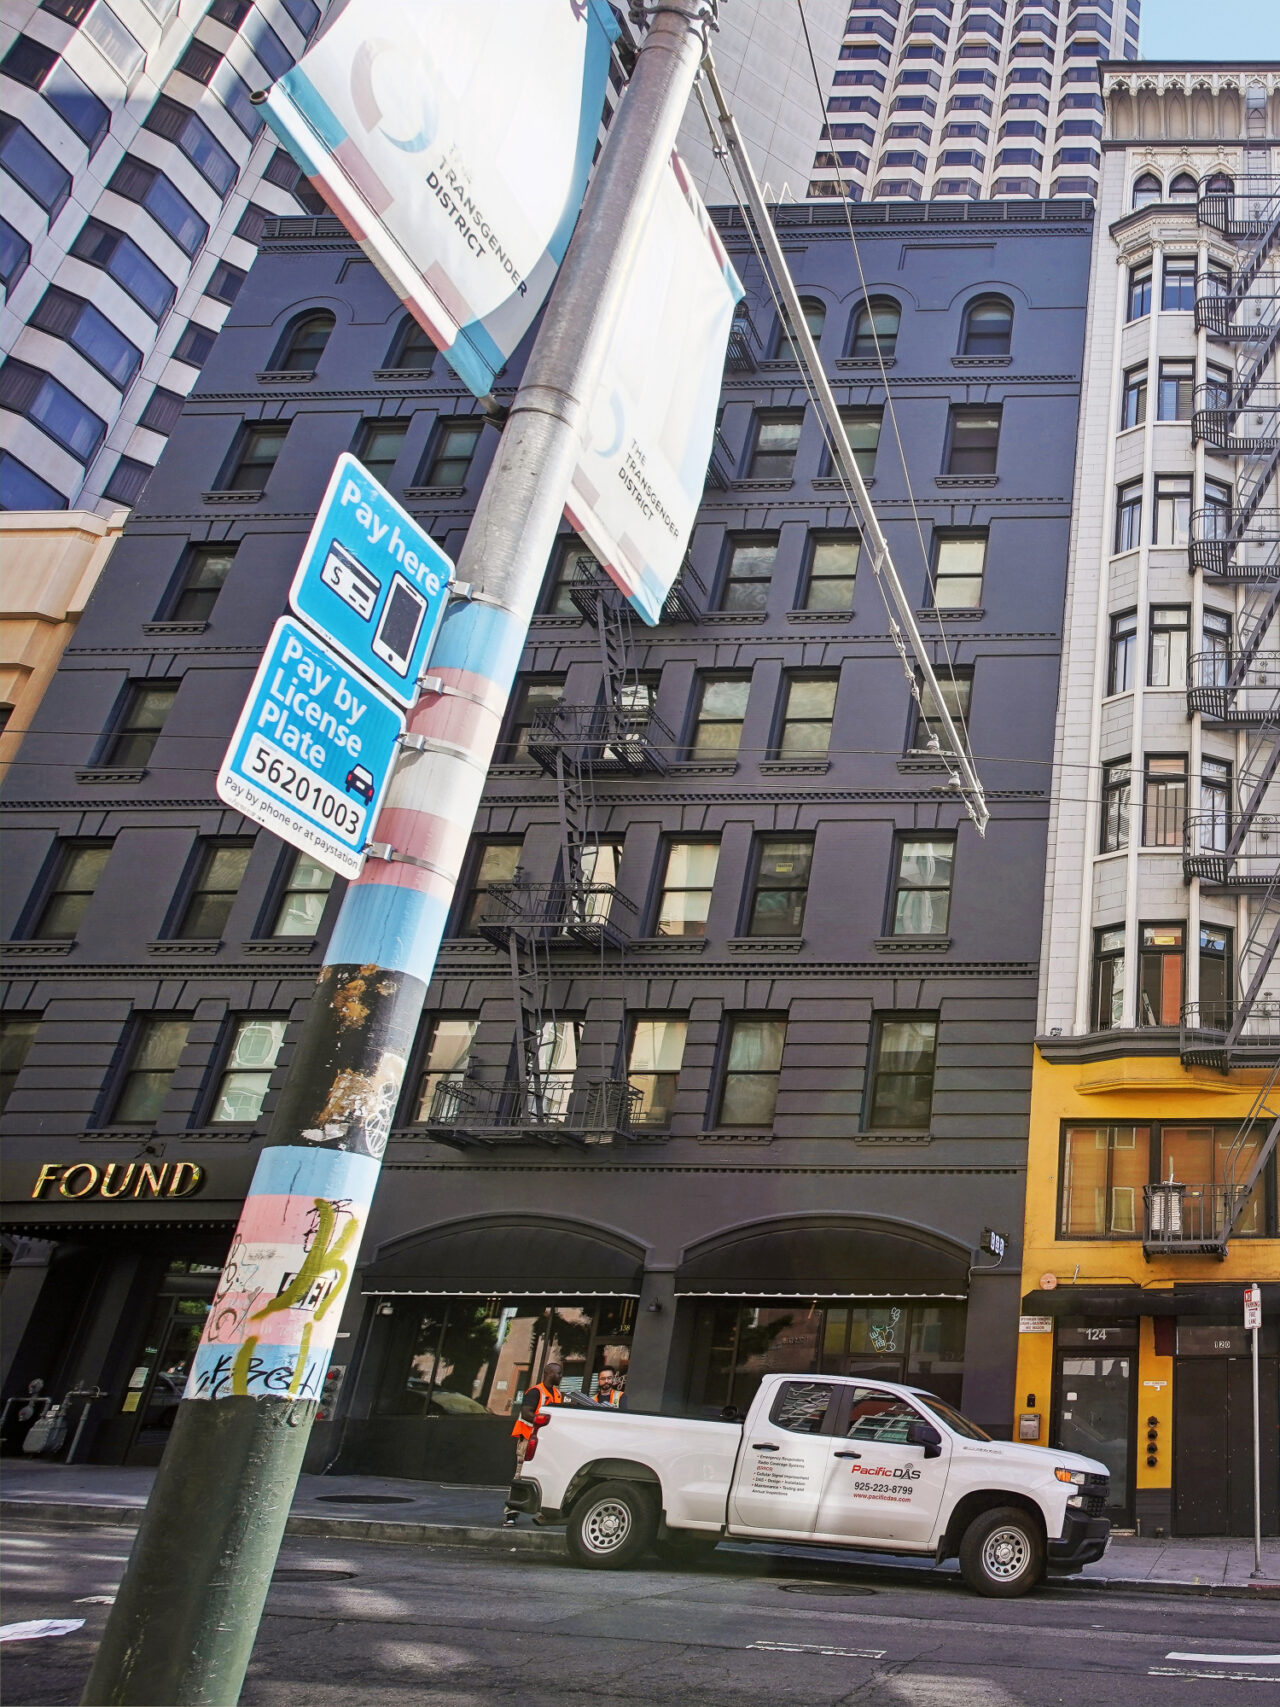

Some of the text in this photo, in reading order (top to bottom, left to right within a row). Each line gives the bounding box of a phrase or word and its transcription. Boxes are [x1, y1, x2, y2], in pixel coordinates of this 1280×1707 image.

[425, 171, 486, 258] DISTRICT
[438, 155, 528, 298] TRANSGENDER
[631, 437, 647, 467] THE
[618, 467, 654, 521] DISTRICT
[626, 452, 680, 540] TRANSGENDER
[340, 479, 441, 597] Pay here
[270, 667, 363, 758] License
[280, 635, 368, 725] Pay by
[257, 699, 327, 769] Plate
[225, 776, 245, 797] Pay
[245, 789, 260, 806] by
[260, 801, 291, 826] phone
[292, 822, 303, 834] or
[303, 828, 315, 842] at
[314, 836, 359, 870] paystation
[252, 747, 361, 836] 56201003
[31, 1162, 202, 1199] FOUND
[1085, 1328, 1107, 1340] 124
[1214, 1341, 1230, 1349] 120
[853, 1493, 911, 1502] www.pacificdas.com
[854, 1482, 913, 1495] 925-223-8799
